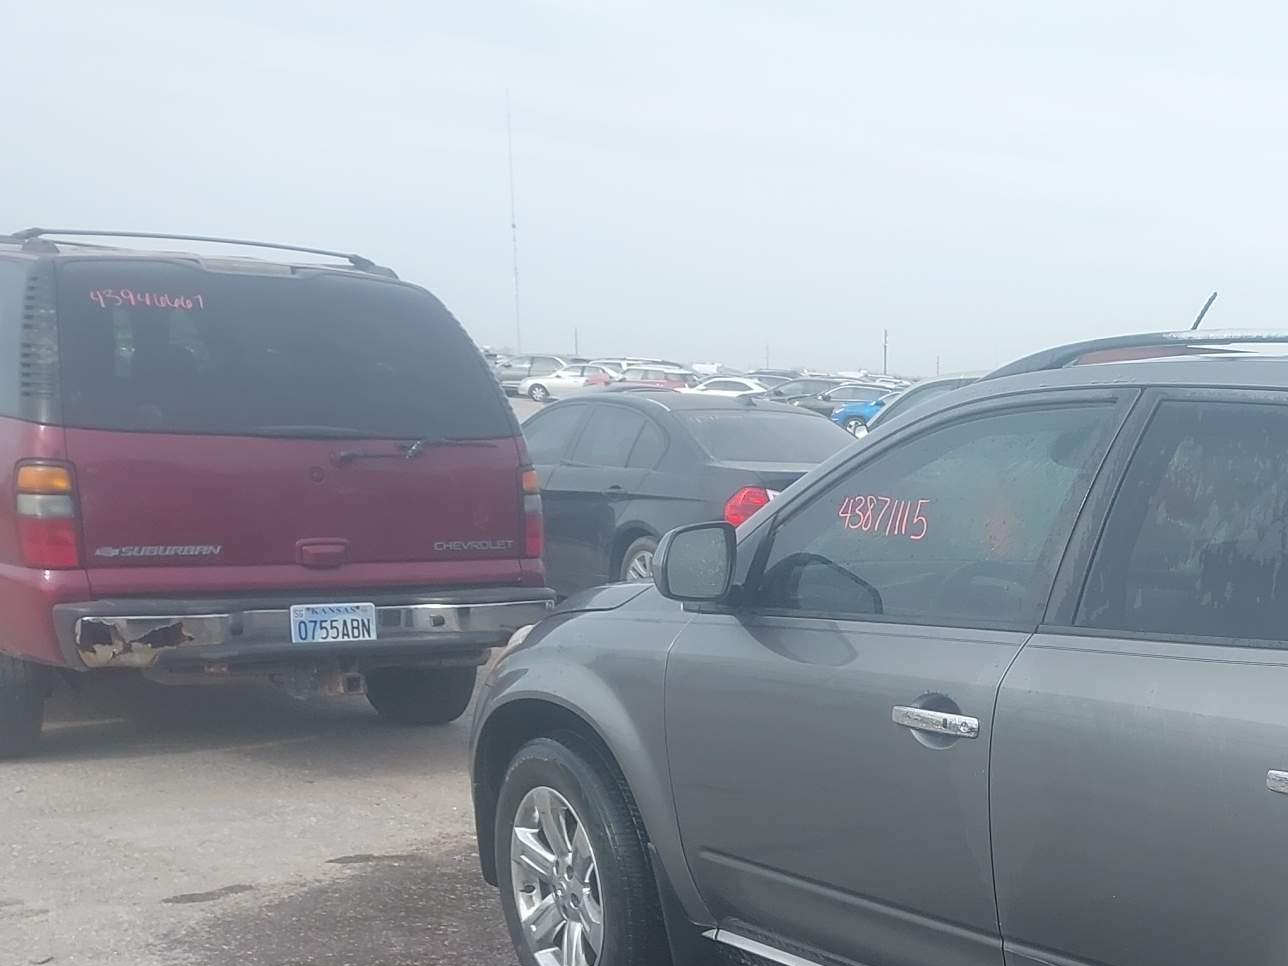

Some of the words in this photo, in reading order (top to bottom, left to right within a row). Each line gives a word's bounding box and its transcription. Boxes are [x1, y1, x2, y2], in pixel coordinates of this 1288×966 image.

[838, 495, 930, 540] 43871115
[120, 545, 222, 557] SUBURBAN
[433, 540, 514, 552] CHEVROLET
[311, 606, 358, 615] KANSAS
[298, 618, 371, 641] 0755ABN
